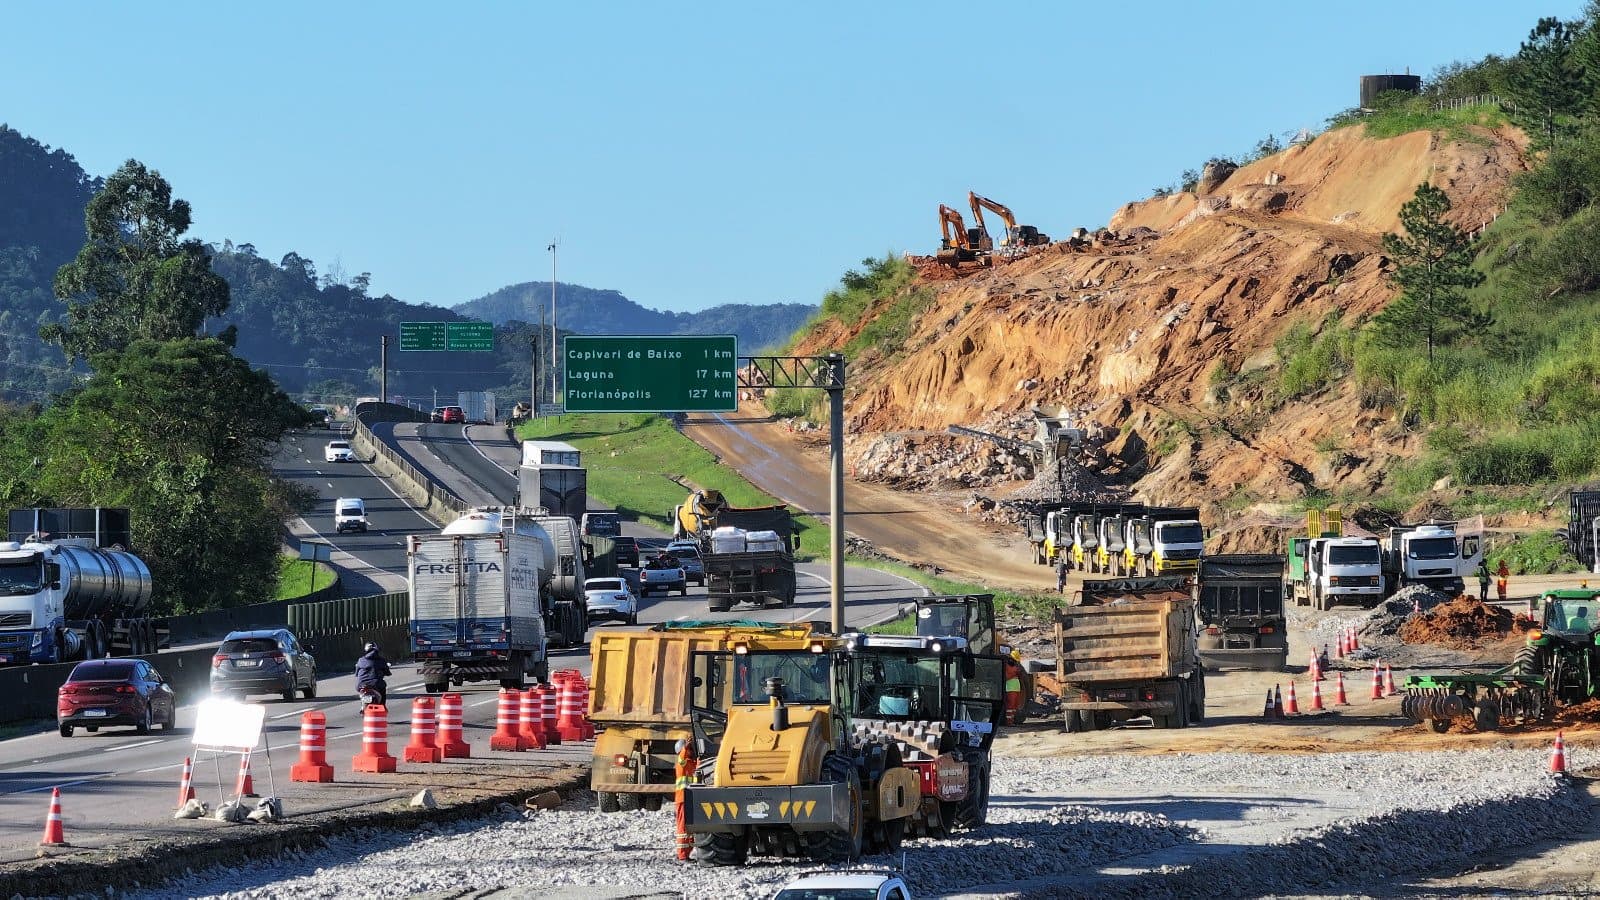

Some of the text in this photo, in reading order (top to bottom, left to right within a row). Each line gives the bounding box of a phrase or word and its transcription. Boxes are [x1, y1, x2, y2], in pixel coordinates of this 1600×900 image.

[569, 350, 732, 361] Capivari de Baixo 1 km
[569, 370, 732, 381] Laguna 17 km
[569, 389, 732, 400] Florianópolis 127 km
[416, 562, 501, 575] FRETTA
